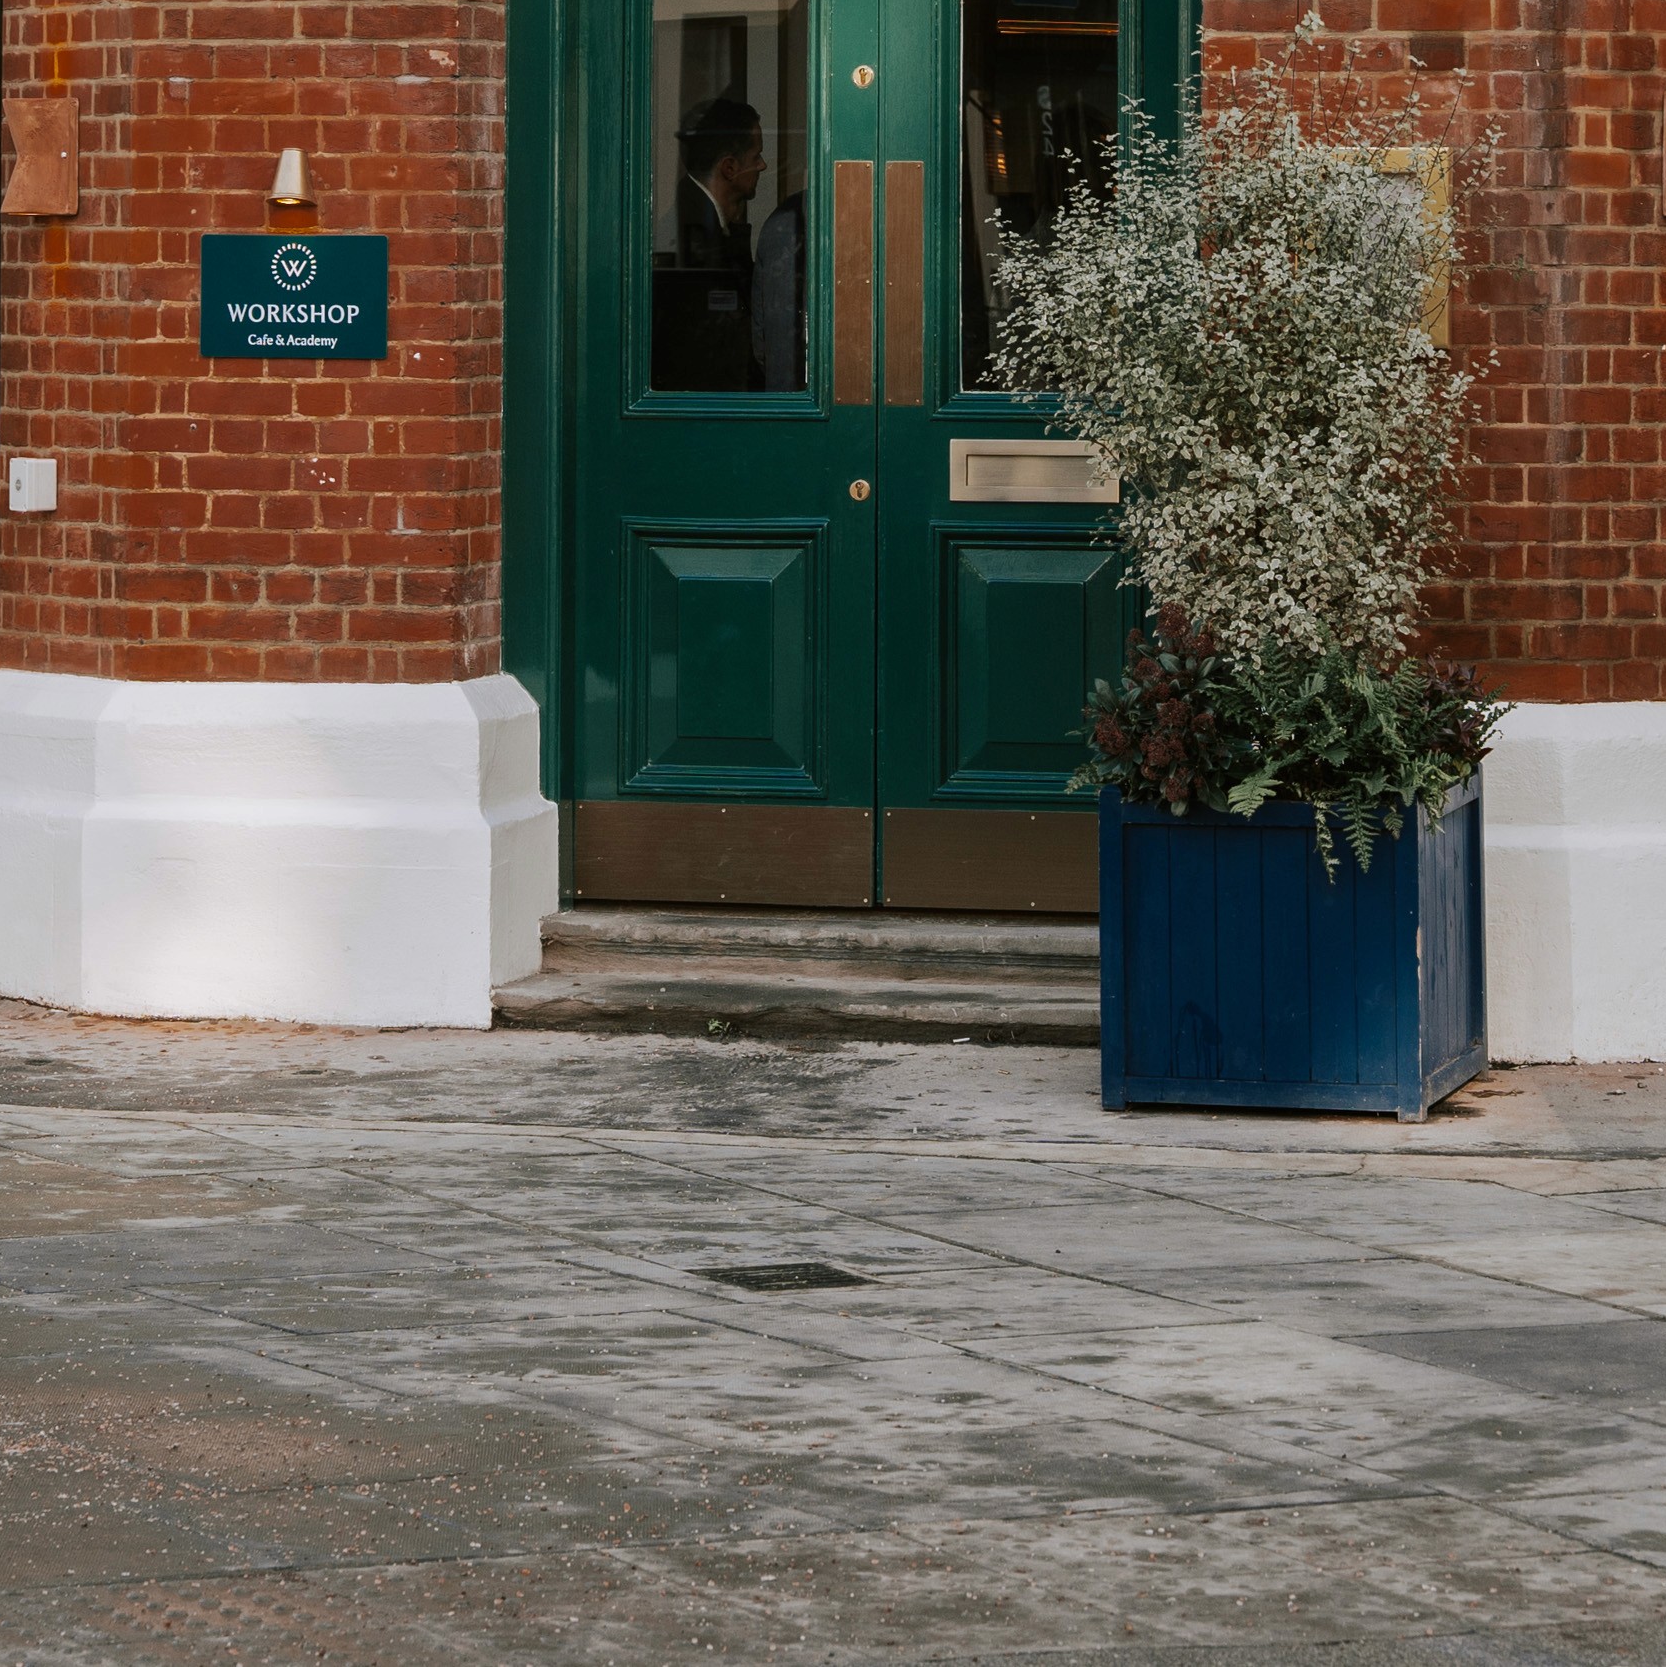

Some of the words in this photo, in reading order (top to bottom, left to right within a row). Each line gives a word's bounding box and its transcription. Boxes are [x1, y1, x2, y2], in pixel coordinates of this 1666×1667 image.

[280, 259, 307, 278] W
[227, 303, 360, 324] WORKSHOP
[247, 334, 274, 346] Cafe
[275, 334, 285, 346] &
[286, 334, 338, 350] Academy
